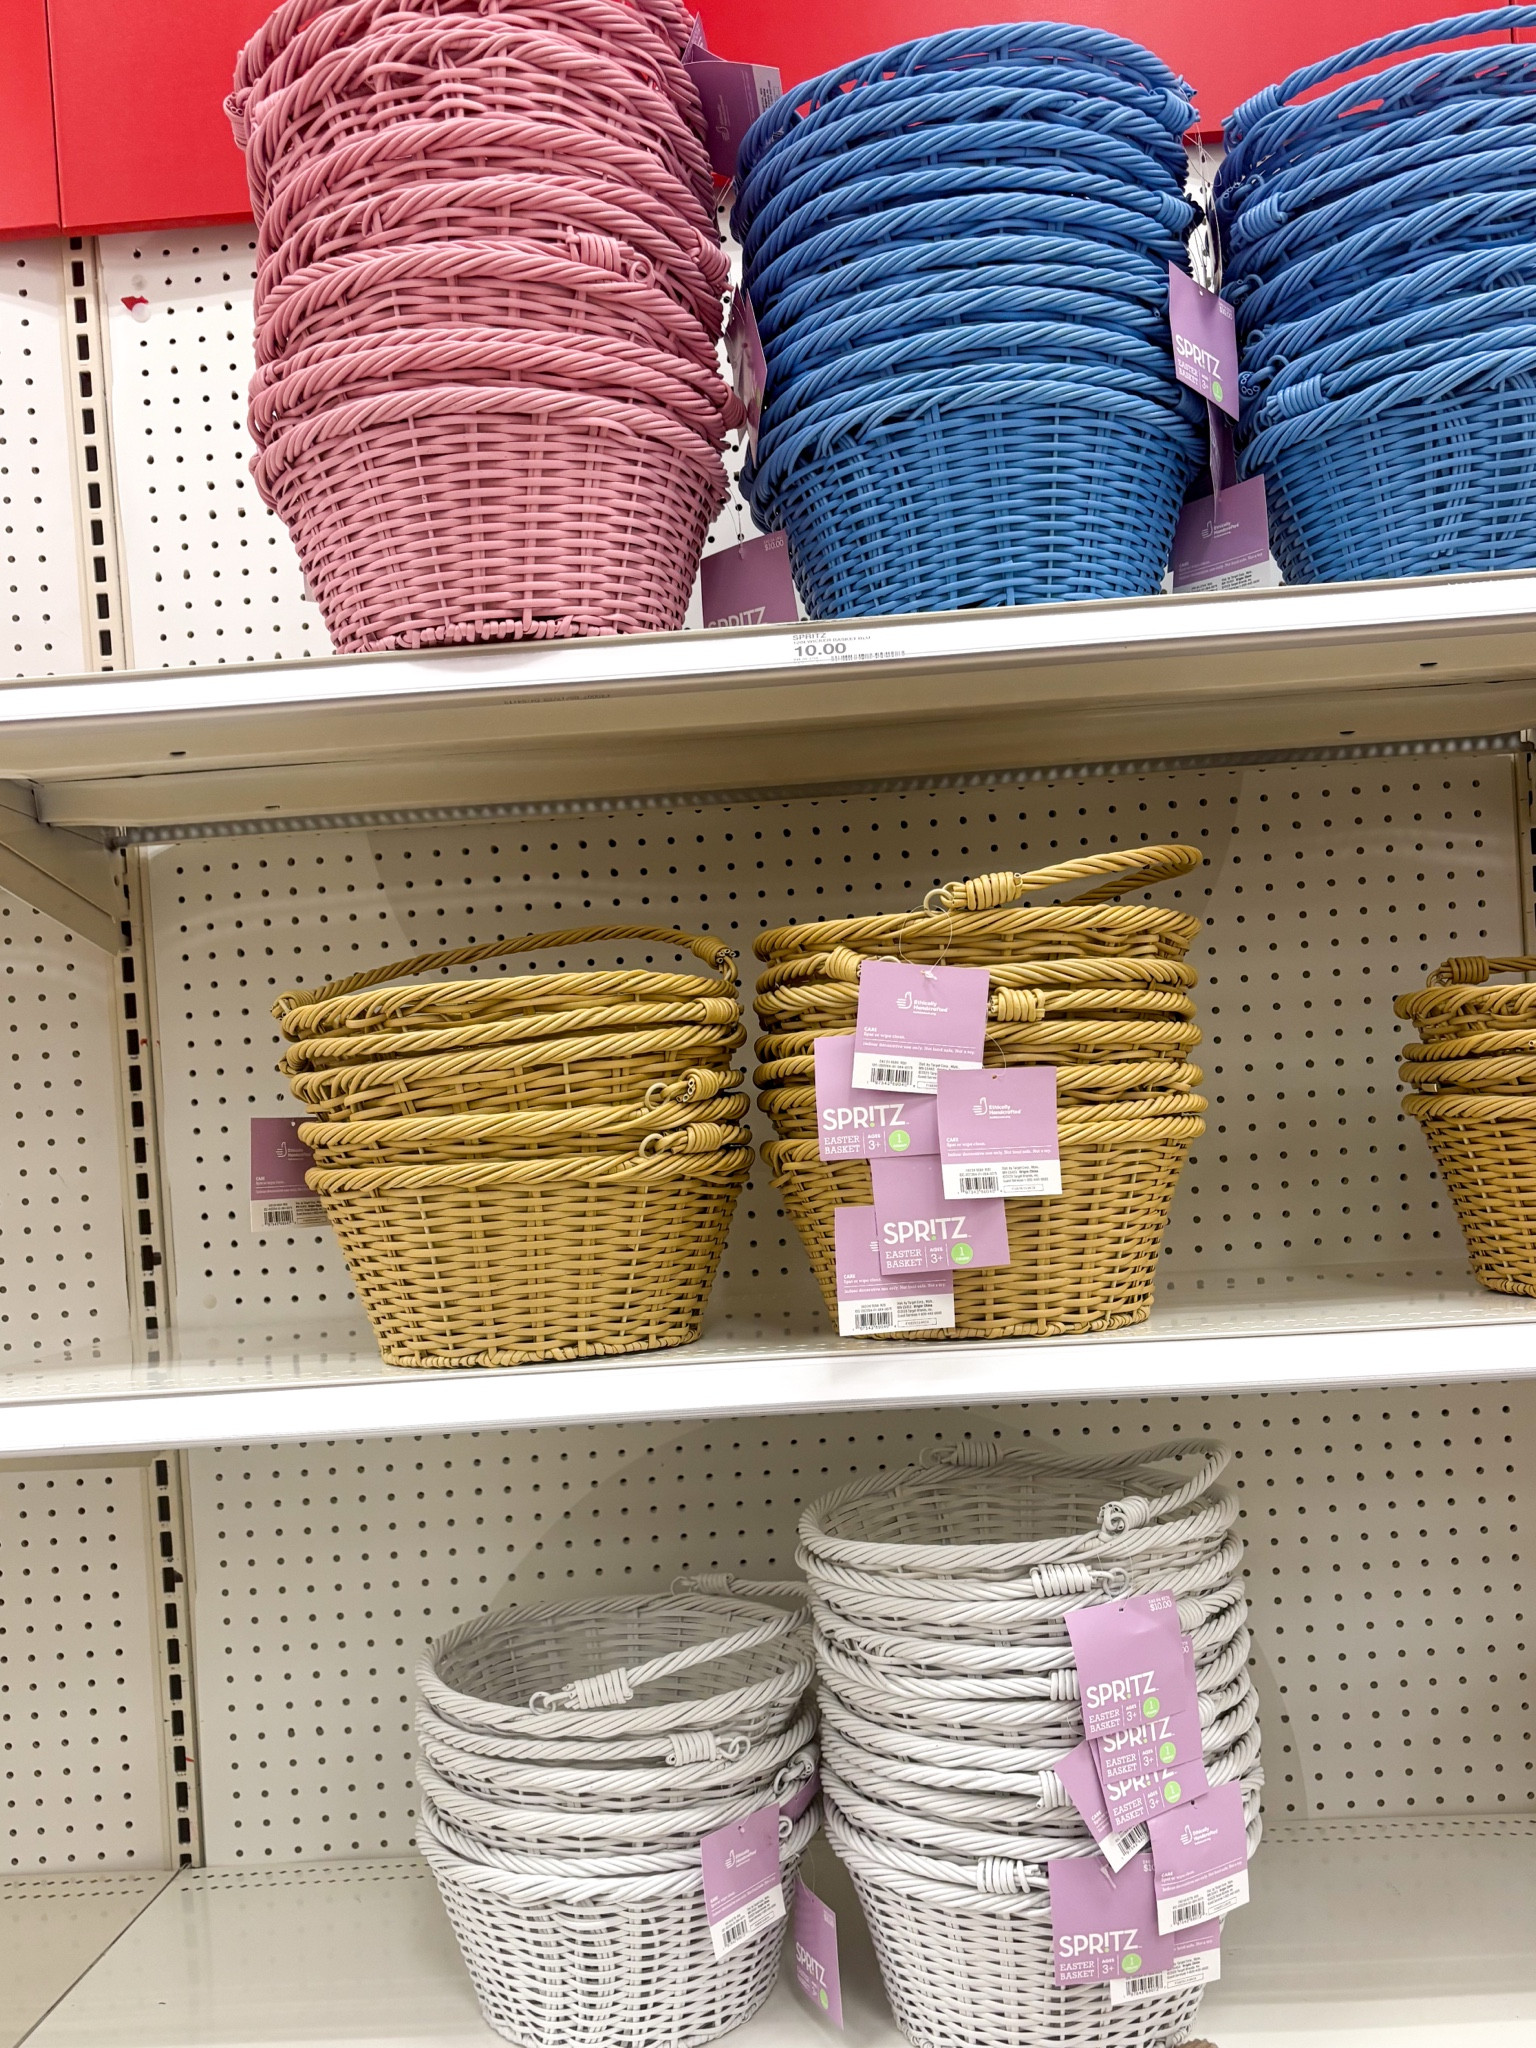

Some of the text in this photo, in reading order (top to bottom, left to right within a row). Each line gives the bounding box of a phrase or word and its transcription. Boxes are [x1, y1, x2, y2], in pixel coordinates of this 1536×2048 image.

[792, 633, 826, 641] SPRITZ
[794, 643, 847, 657] 10.00
[824, 1135, 860, 1145] EASTER
[868, 1140, 881, 1150] 3+
[824, 1144, 861, 1154] BASKET
[885, 1249, 922, 1259] EASTER
[930, 1253, 943, 1264] 3+
[886, 1258, 923, 1269] BASKET
[1150, 1600, 1172, 1612] $10.00
[1089, 1708, 1120, 1724] EASTER
[1126, 1711, 1137, 1722] 3+
[1090, 1718, 1121, 1733] BASKET
[1105, 1753, 1137, 1768] EASTER
[1143, 1756, 1154, 1767] 3+
[1107, 1762, 1137, 1777] BASKET
[1113, 1797, 1143, 1816] EASTER
[1149, 1798, 1159, 1809] 3+
[1115, 1807, 1144, 1826] BASKET
[1060, 1960, 1095, 1972] EASTER
[1102, 1964, 1115, 1975] 3+
[1060, 1969, 1095, 1981] BASKET
